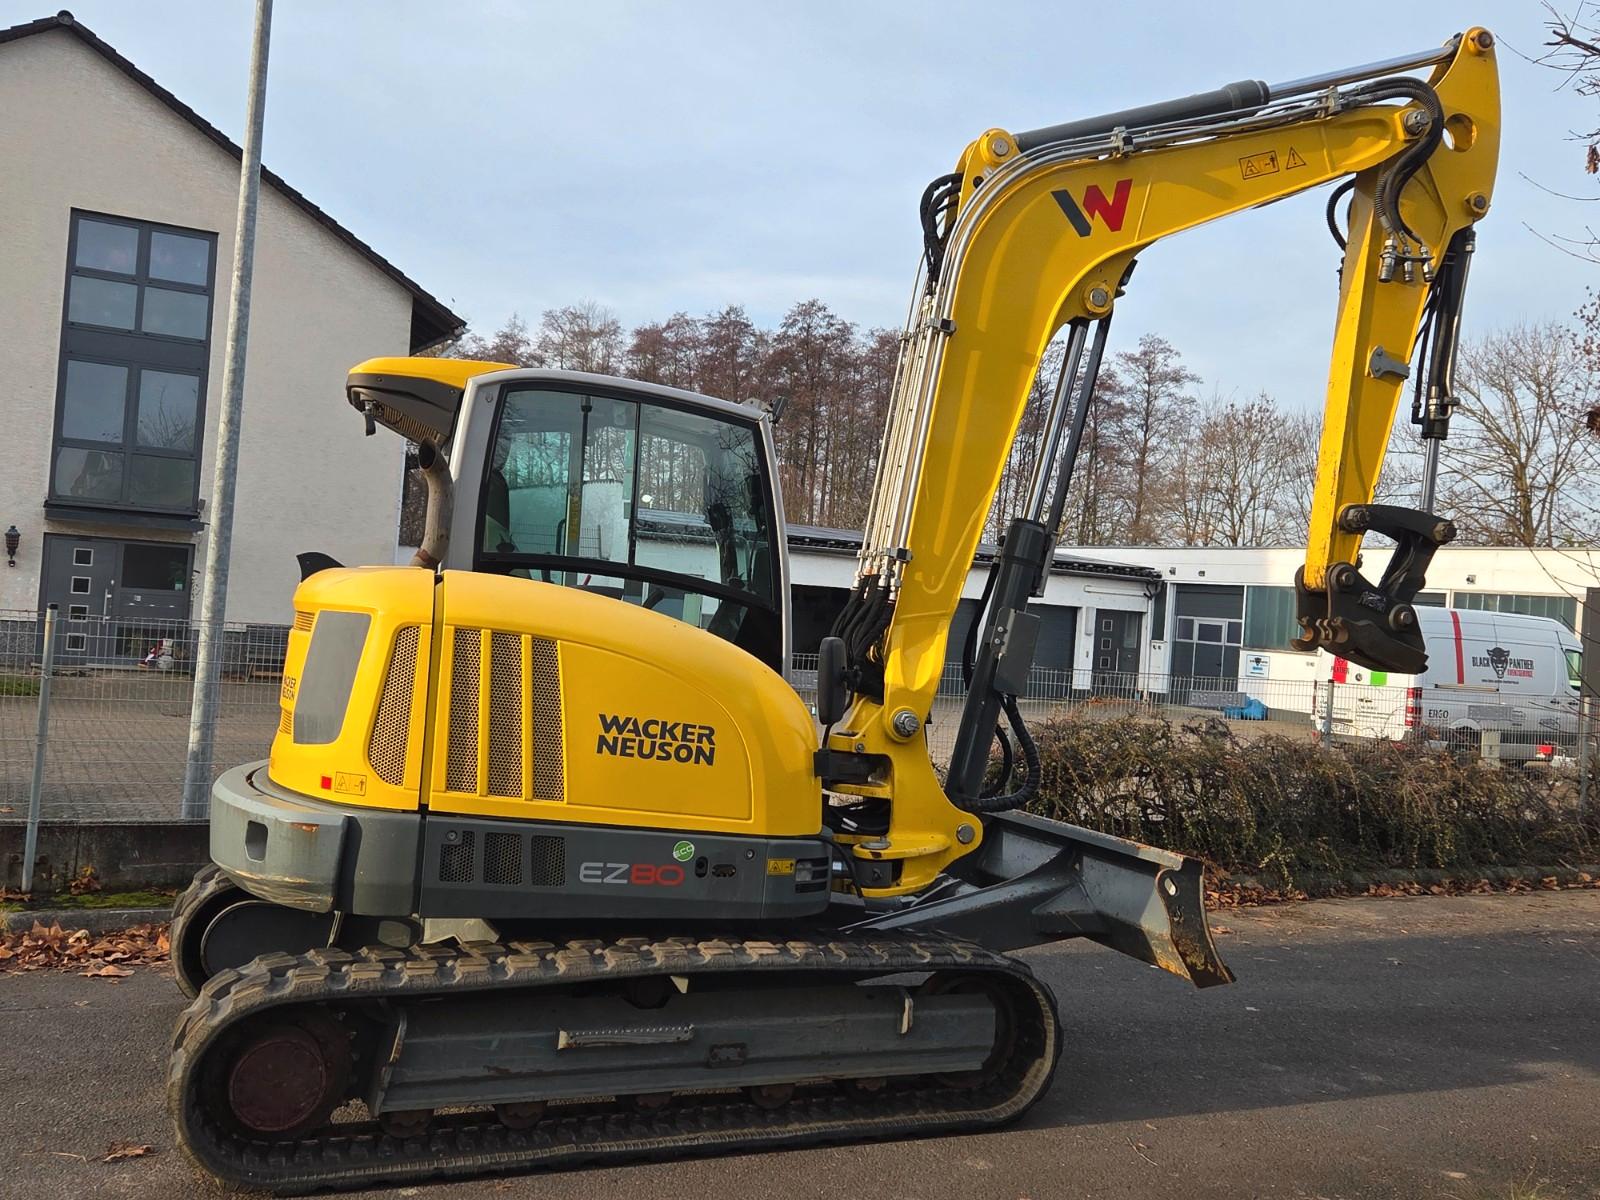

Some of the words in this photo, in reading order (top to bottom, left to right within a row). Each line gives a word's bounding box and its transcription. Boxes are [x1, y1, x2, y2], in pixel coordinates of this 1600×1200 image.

[1472, 656, 1491, 667] BLACK
[1508, 658, 1535, 670] PANTHER
[598, 713, 716, 745] WACKER
[596, 735, 716, 766] NEUSON
[673, 842, 695, 859] ECO
[579, 862, 686, 886] EZ80
